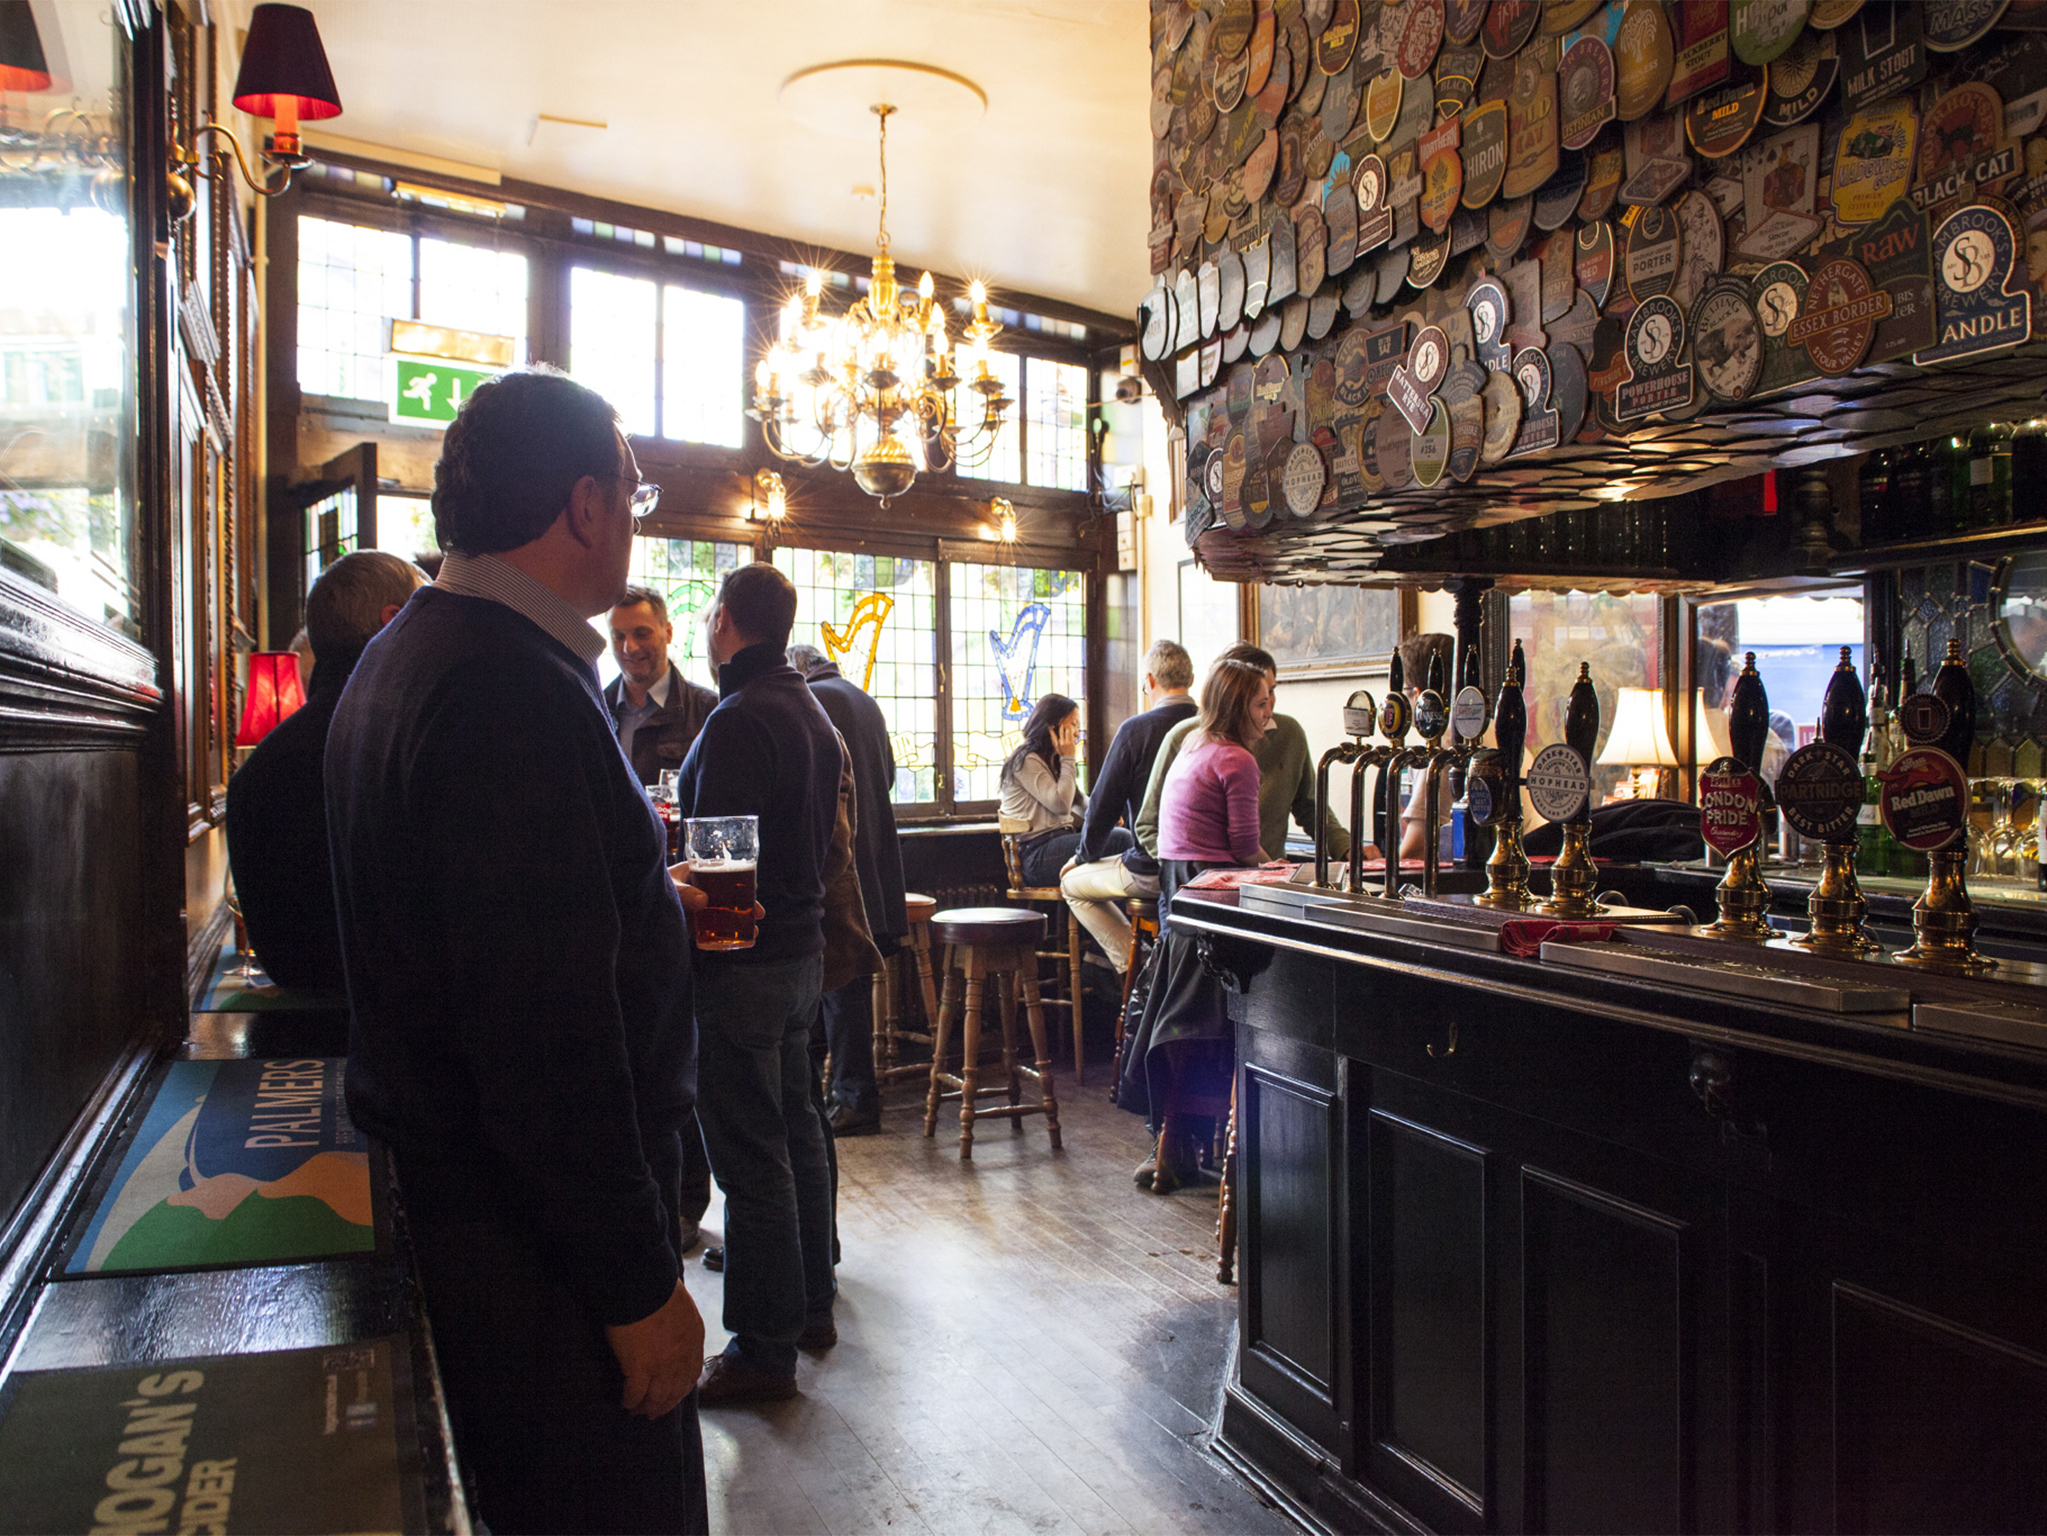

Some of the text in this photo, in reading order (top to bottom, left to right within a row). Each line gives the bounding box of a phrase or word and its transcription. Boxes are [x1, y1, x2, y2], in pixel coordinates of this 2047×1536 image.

[1930, 1, 1995, 35] MASS
[1848, 66, 1876, 98] MILK
[1880, 44, 1916, 81] STOUT
[1440, 79, 1468, 93] BLACK
[1778, 87, 1818, 116] MILD
[1912, 151, 2010, 209] BLACK CAT
[1581, 265, 1598, 279] RED
[1633, 253, 1672, 274] PORTER
[1808, 264, 1866, 310] NETHERGATE
[1937, 266, 2004, 308] BREWERY
[1629, 302, 1680, 346] SAMBROOK'S
[1699, 297, 1742, 334] BEIJING
[1793, 295, 1883, 338] ESSEX BORDER
[1941, 306, 2023, 344] ANDLE
[1631, 344, 1677, 376] BREWERY
[1839, 332, 1864, 367] VALLEY
[1395, 370, 1430, 418] BATTERSEA
[1621, 371, 1688, 400] POWERHOUSE
[1632, 387, 1678, 407] PORTER
[1402, 393, 1416, 413] RYE
[1421, 445, 1436, 455] #256
[1286, 472, 1322, 487] HOPHEAD
[1537, 749, 1582, 775] DARK STAR
[1787, 752, 1850, 779] DARK STAR
[1530, 776, 1586, 790] HOPHEAD
[1780, 781, 1862, 800] PARTRIDGE
[1701, 790, 1759, 815] LONDON
[1891, 786, 1956, 812] Red Dawn
[1706, 809, 1749, 827] PRIDE
[1787, 806, 1813, 832] BEST
[1818, 805, 1854, 833] BITTER
[244, 1060, 325, 1149] PALMERS
